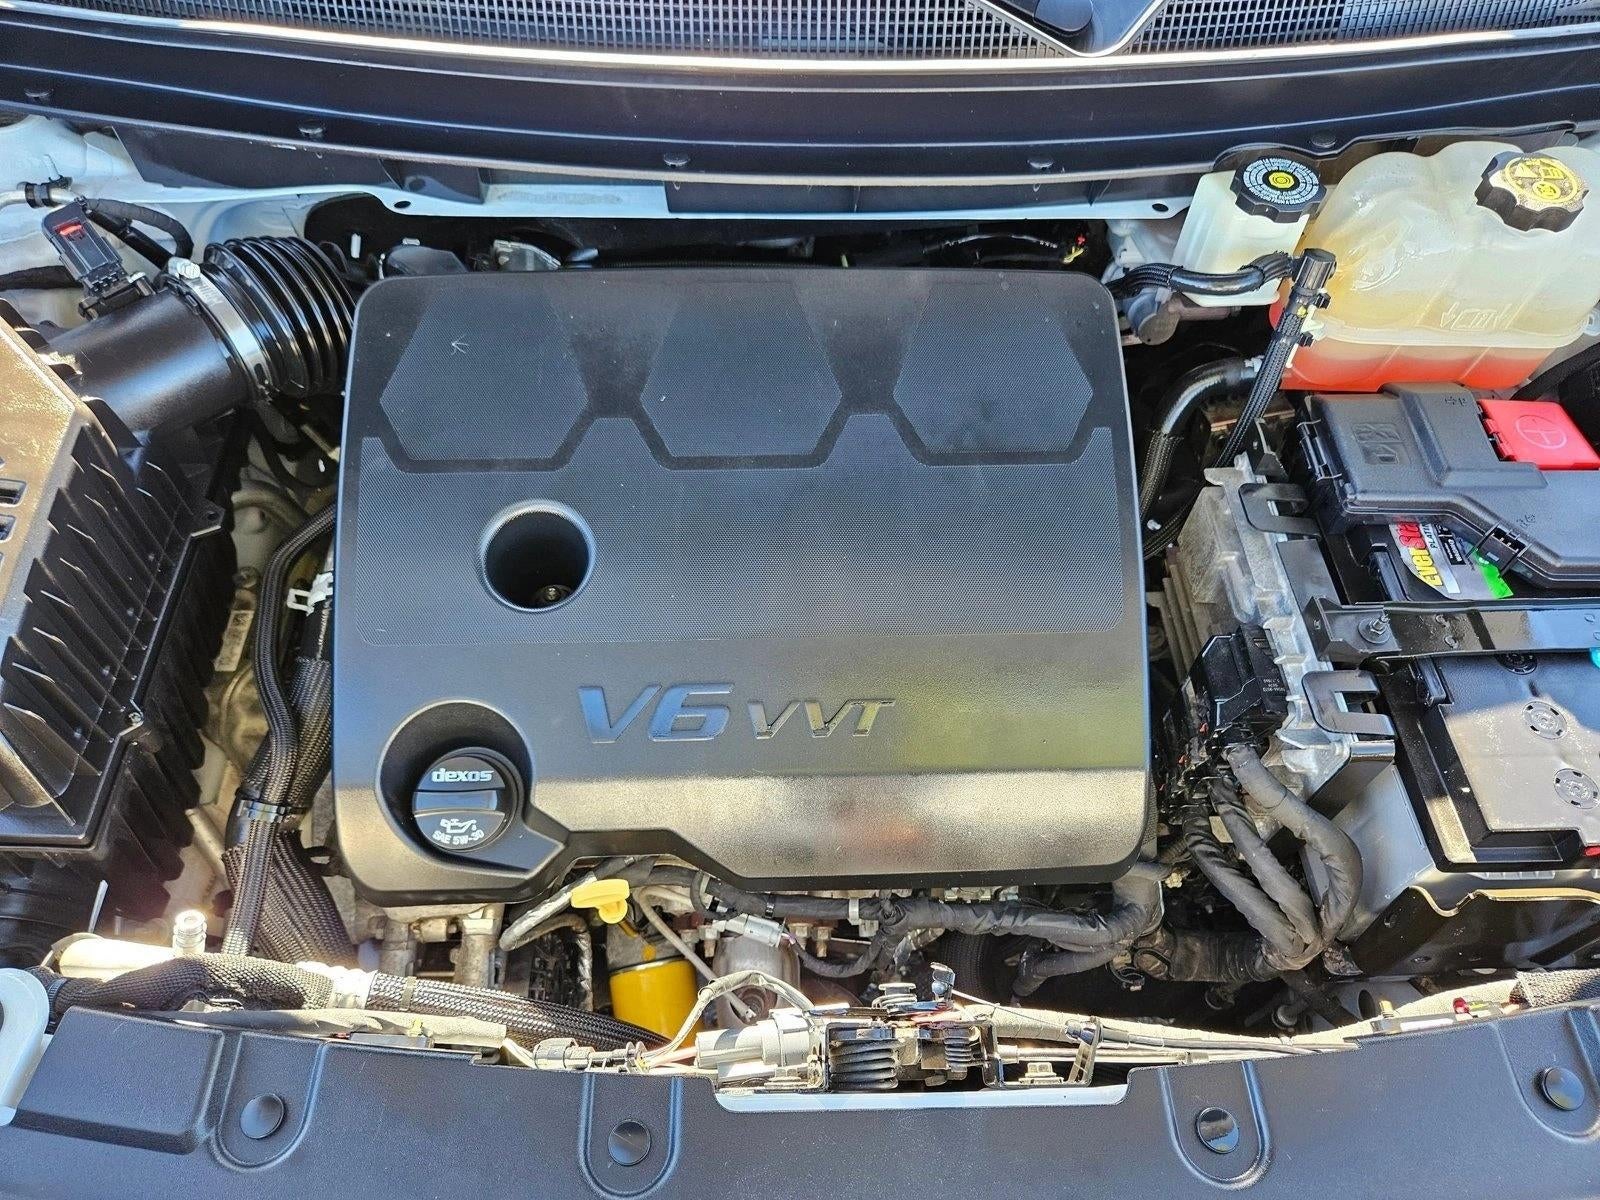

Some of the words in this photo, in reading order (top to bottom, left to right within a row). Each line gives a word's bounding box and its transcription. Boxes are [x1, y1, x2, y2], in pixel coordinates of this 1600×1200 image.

[1396, 521, 1443, 586] EverSta
[578, 683, 735, 743] V6
[748, 699, 895, 740] VVT
[431, 768, 495, 782] dexos
[432, 830, 452, 844] SAE
[452, 829, 484, 845] 5W-30
